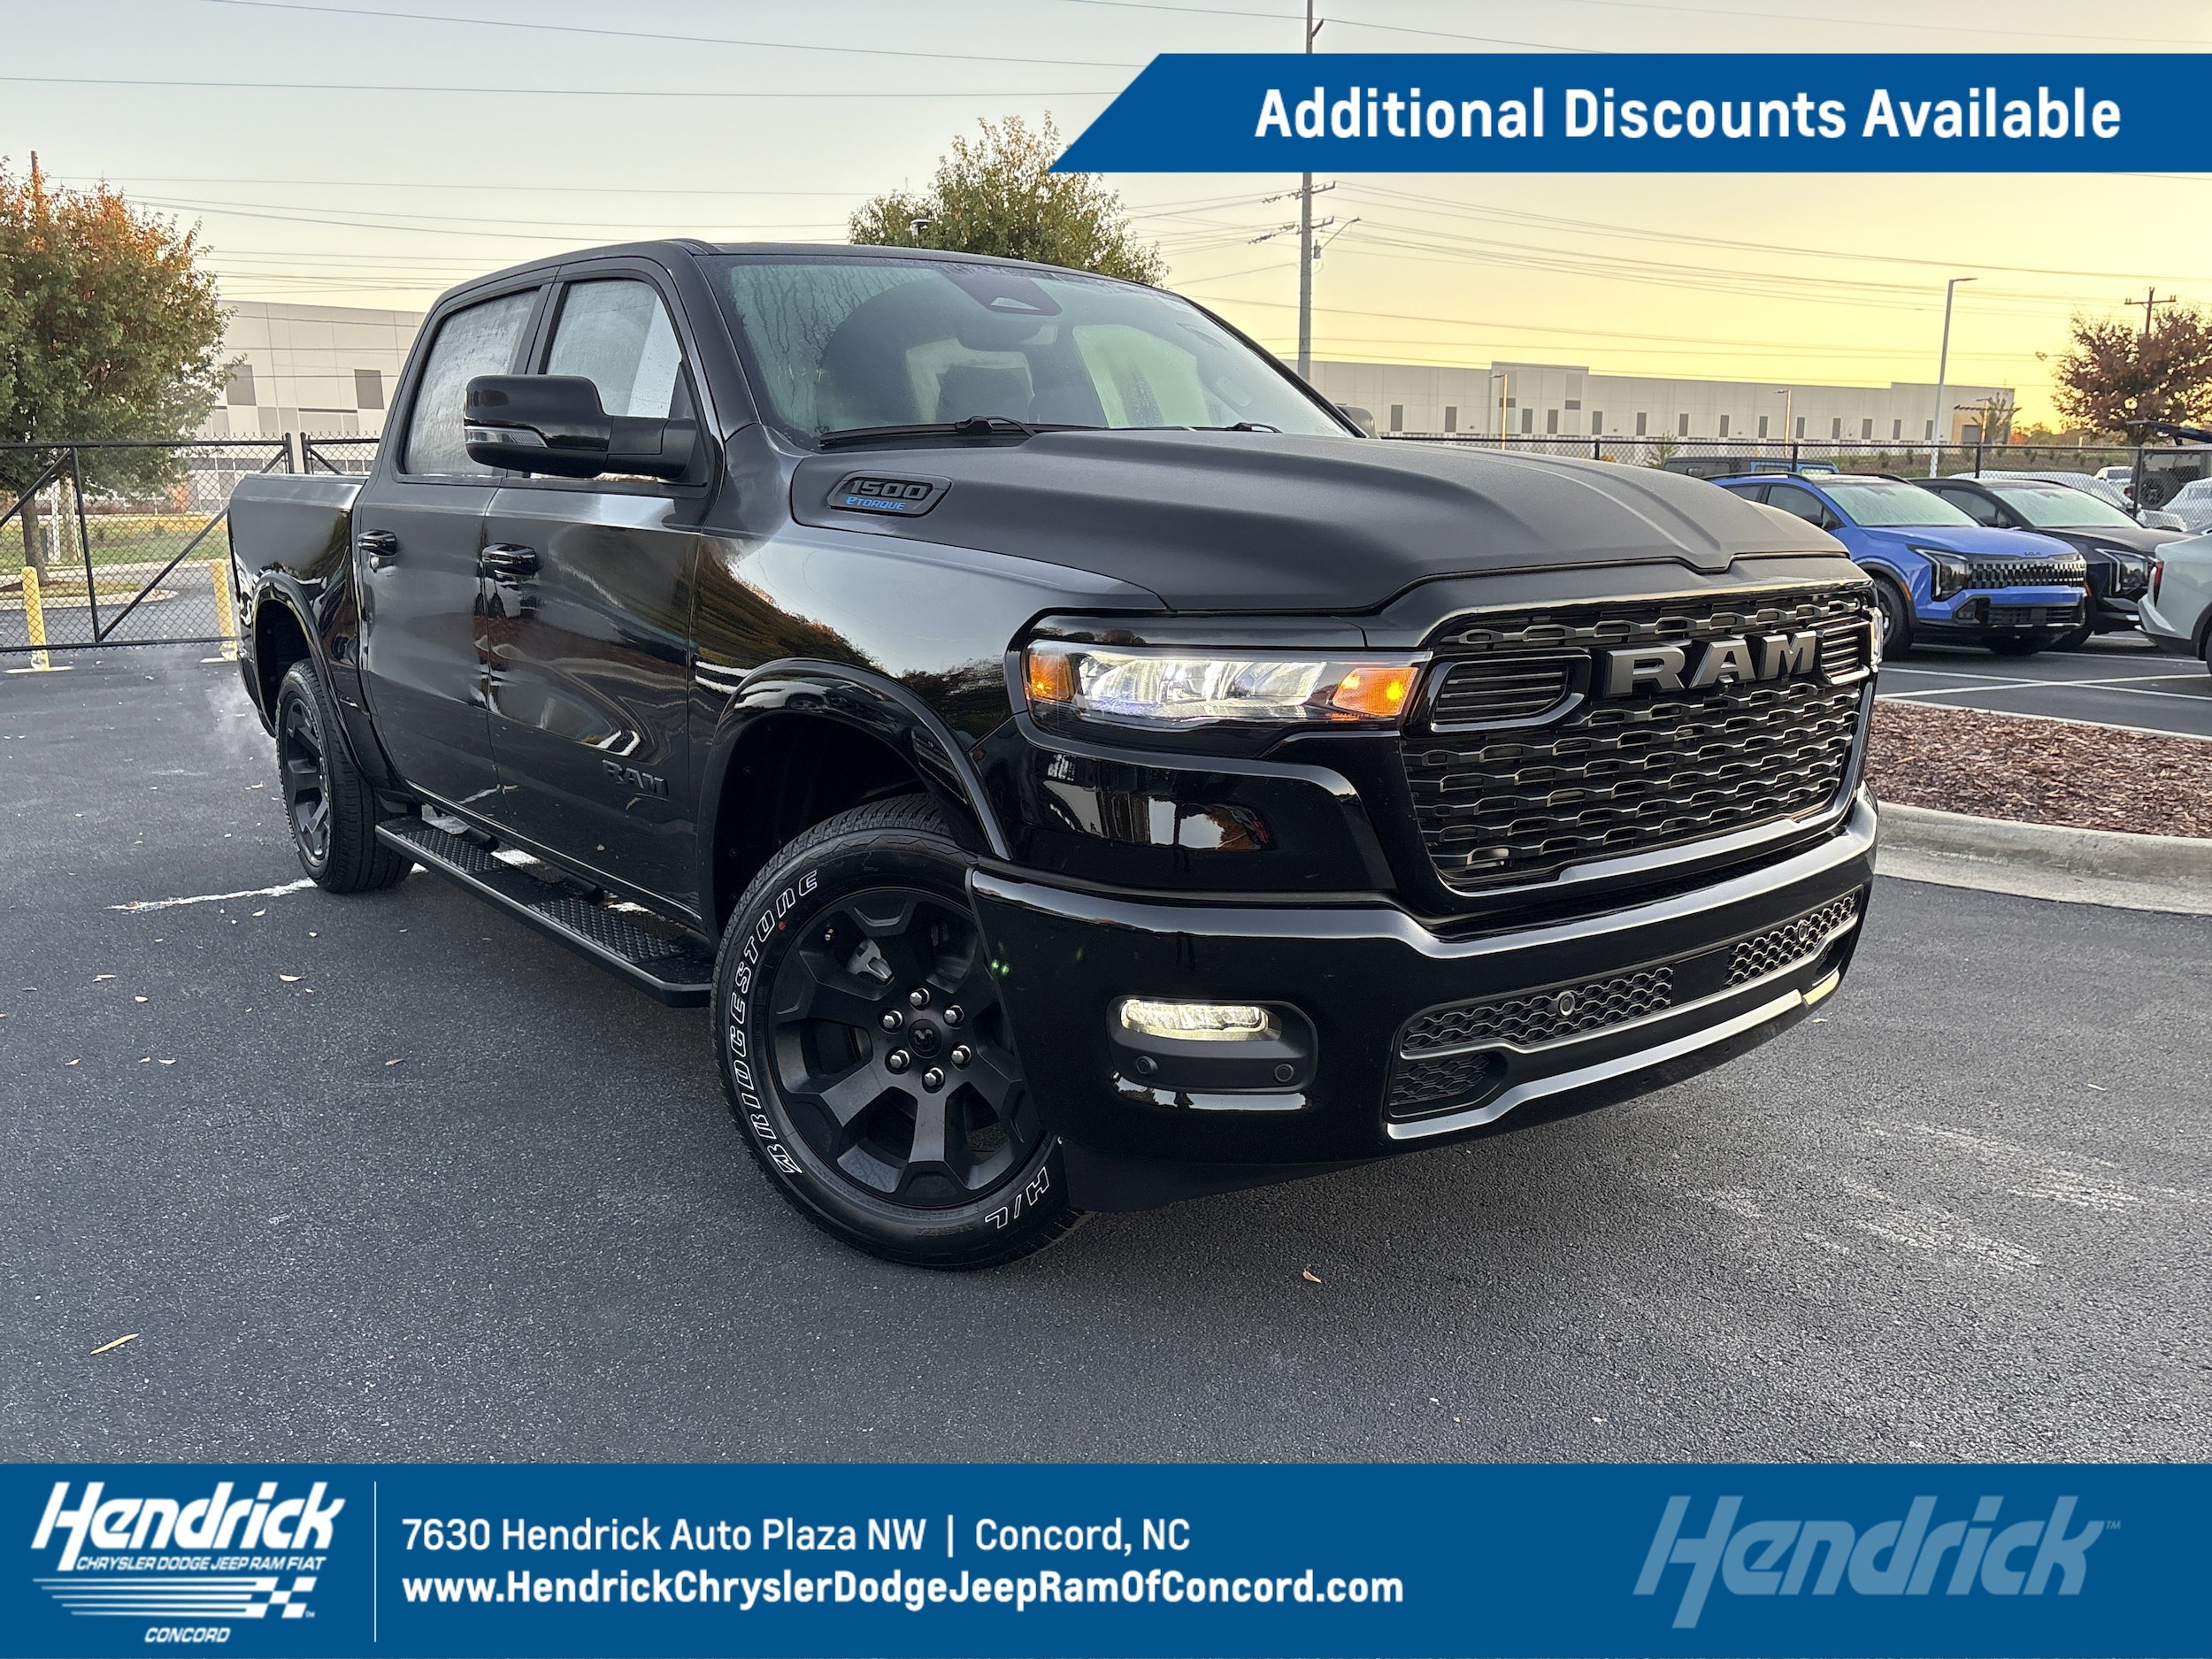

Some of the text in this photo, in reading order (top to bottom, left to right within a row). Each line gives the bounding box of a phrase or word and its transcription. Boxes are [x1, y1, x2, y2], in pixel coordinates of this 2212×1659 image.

[850, 480, 927, 499] 1500
[1605, 630, 1817, 698] RAM
[602, 759, 669, 796] RAM
[728, 870, 818, 1175] BRIDGESTONE
[985, 1166, 1051, 1229] H/L
